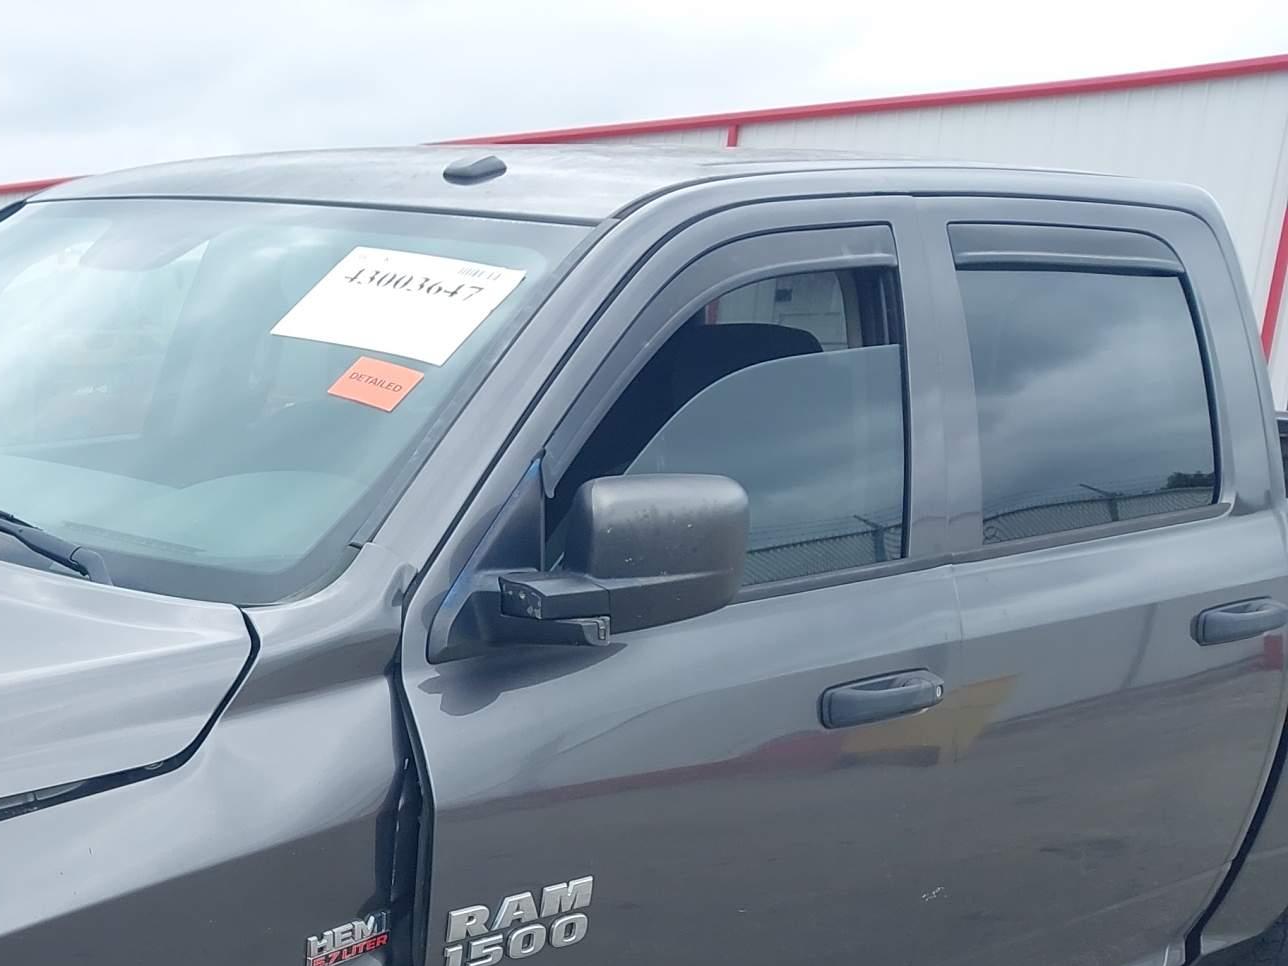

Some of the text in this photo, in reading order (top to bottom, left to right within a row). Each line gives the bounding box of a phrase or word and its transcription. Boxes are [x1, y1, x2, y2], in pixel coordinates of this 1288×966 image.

[345, 267, 484, 301] 43003647
[348, 371, 402, 394] DETAILED
[446, 875, 594, 943] RAM
[341, 933, 389, 961] LITER
